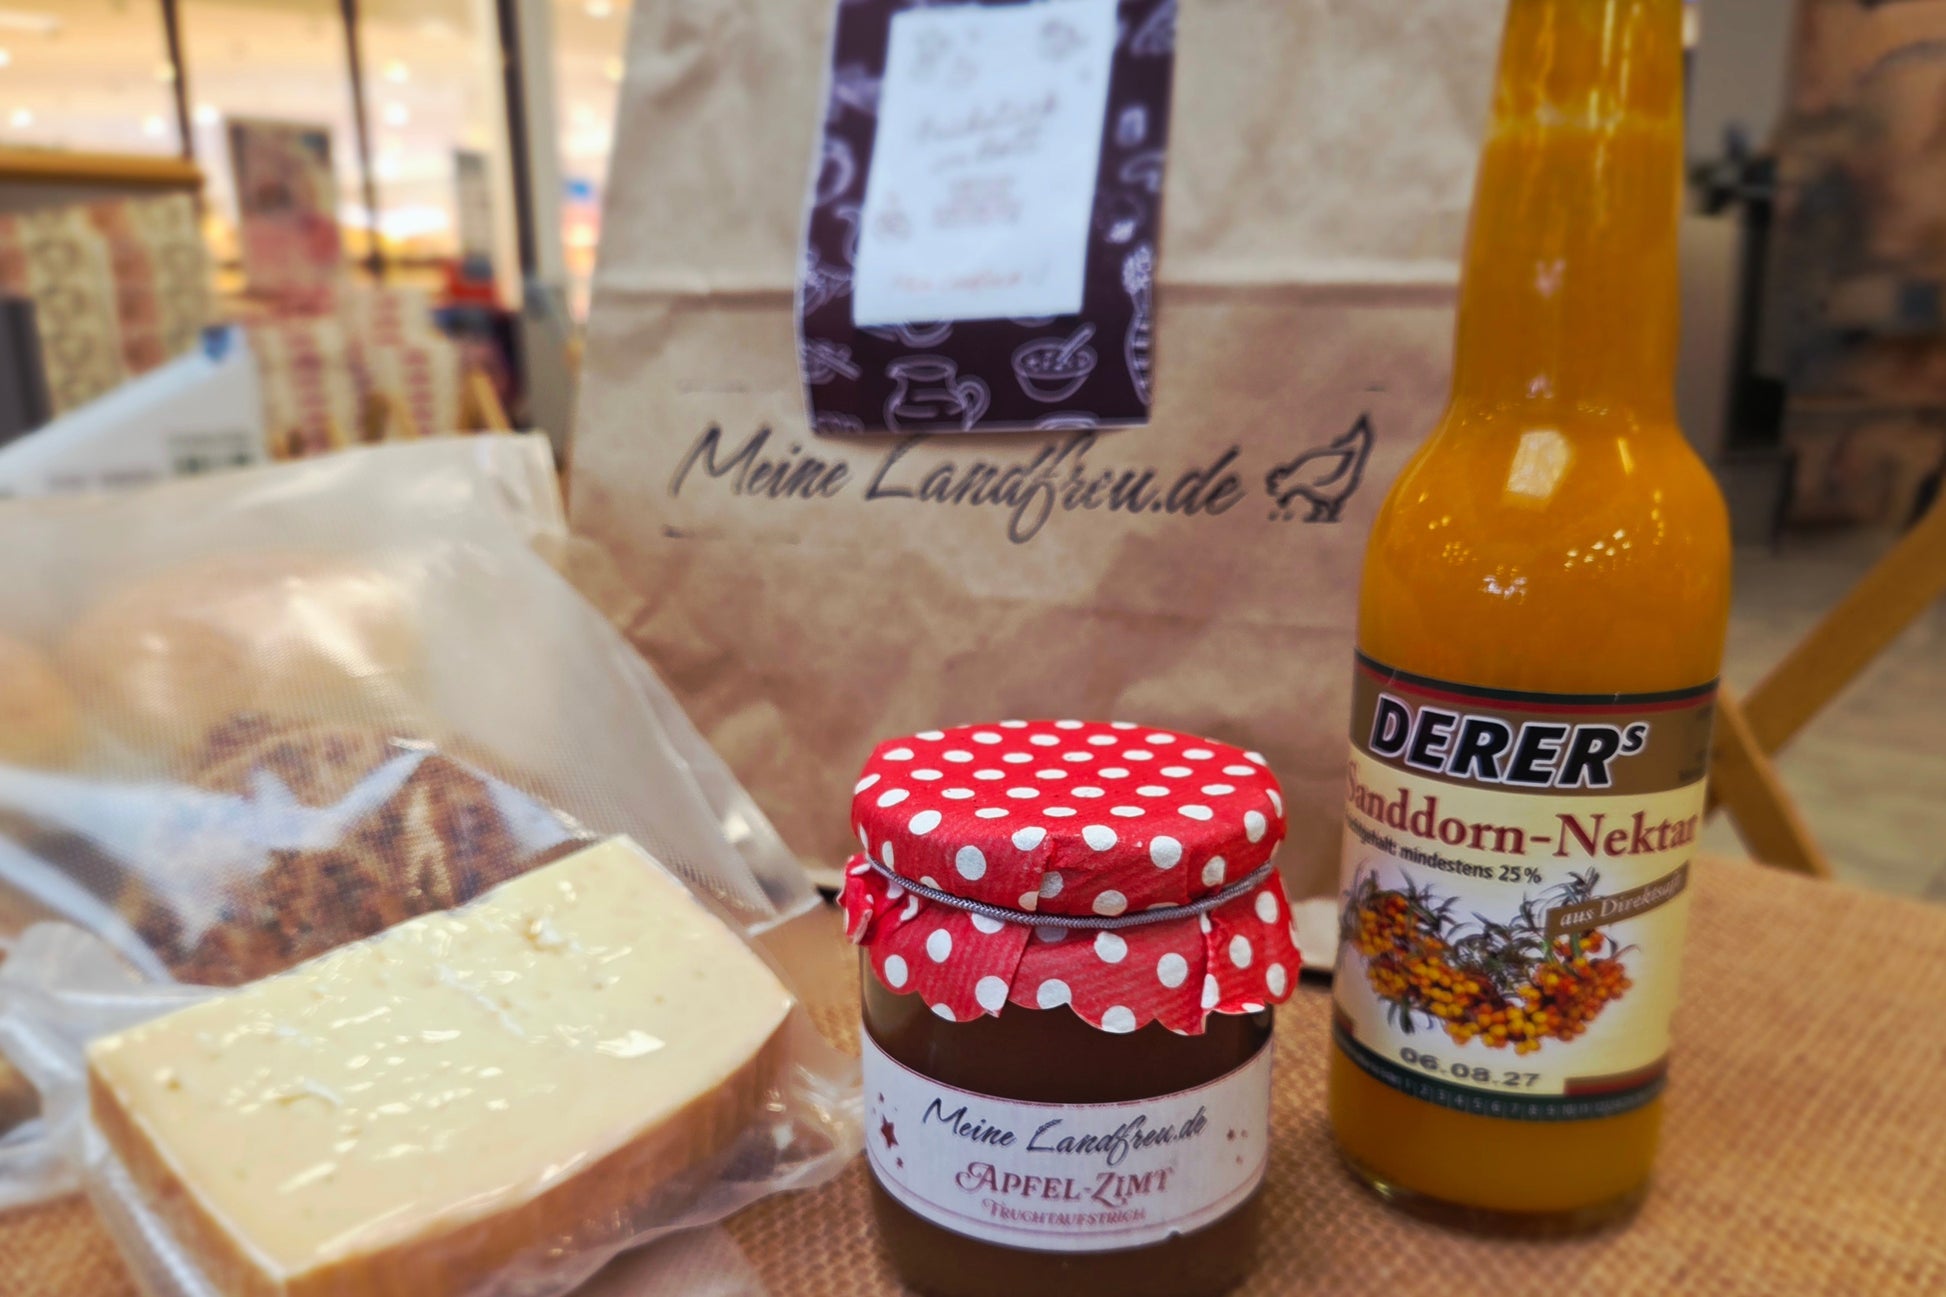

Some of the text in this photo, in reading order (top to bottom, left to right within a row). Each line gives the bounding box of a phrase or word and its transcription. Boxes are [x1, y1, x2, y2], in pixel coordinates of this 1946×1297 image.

[670, 421, 852, 501] Meine
[1401, 846, 1494, 880] mindestens
[1559, 908, 1596, 928] aus
[1400, 1047, 1541, 1087] 06.08.27
[921, 1097, 1209, 1166] Meine Landfreu.de
[955, 1161, 1175, 1208] APFEL-ZIMT
[982, 1198, 1147, 1226] FRUCHTAUFSTRICH
